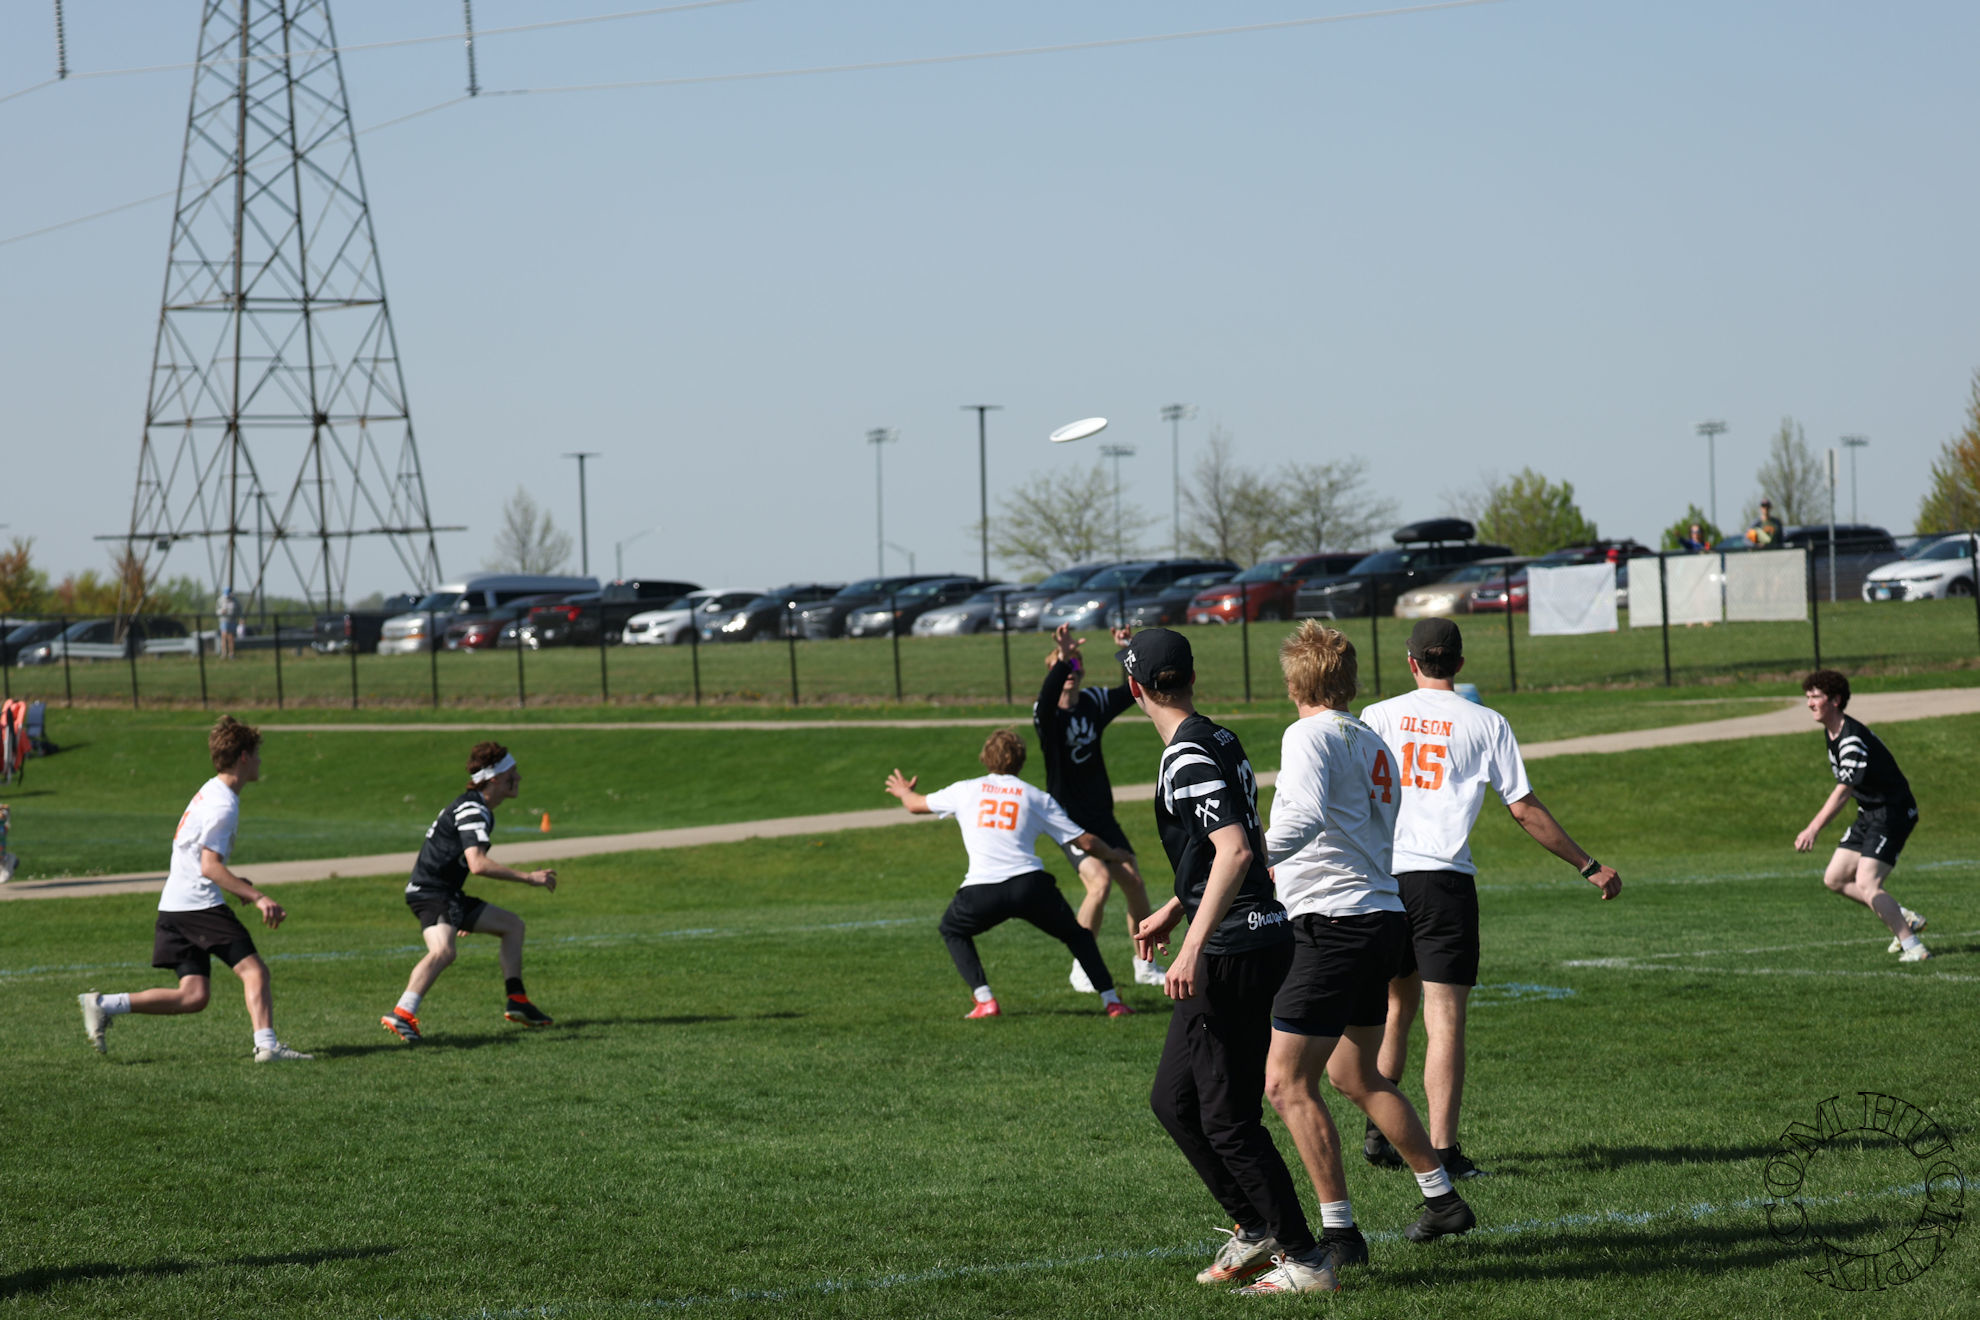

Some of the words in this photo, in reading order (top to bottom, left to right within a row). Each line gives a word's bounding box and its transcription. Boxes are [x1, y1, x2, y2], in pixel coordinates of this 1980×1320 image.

[1400, 716, 1453, 737] OLSON
[1363, 747, 1392, 804] 4
[1400, 741, 1447, 790] 15
[977, 799, 1019, 831] 29
